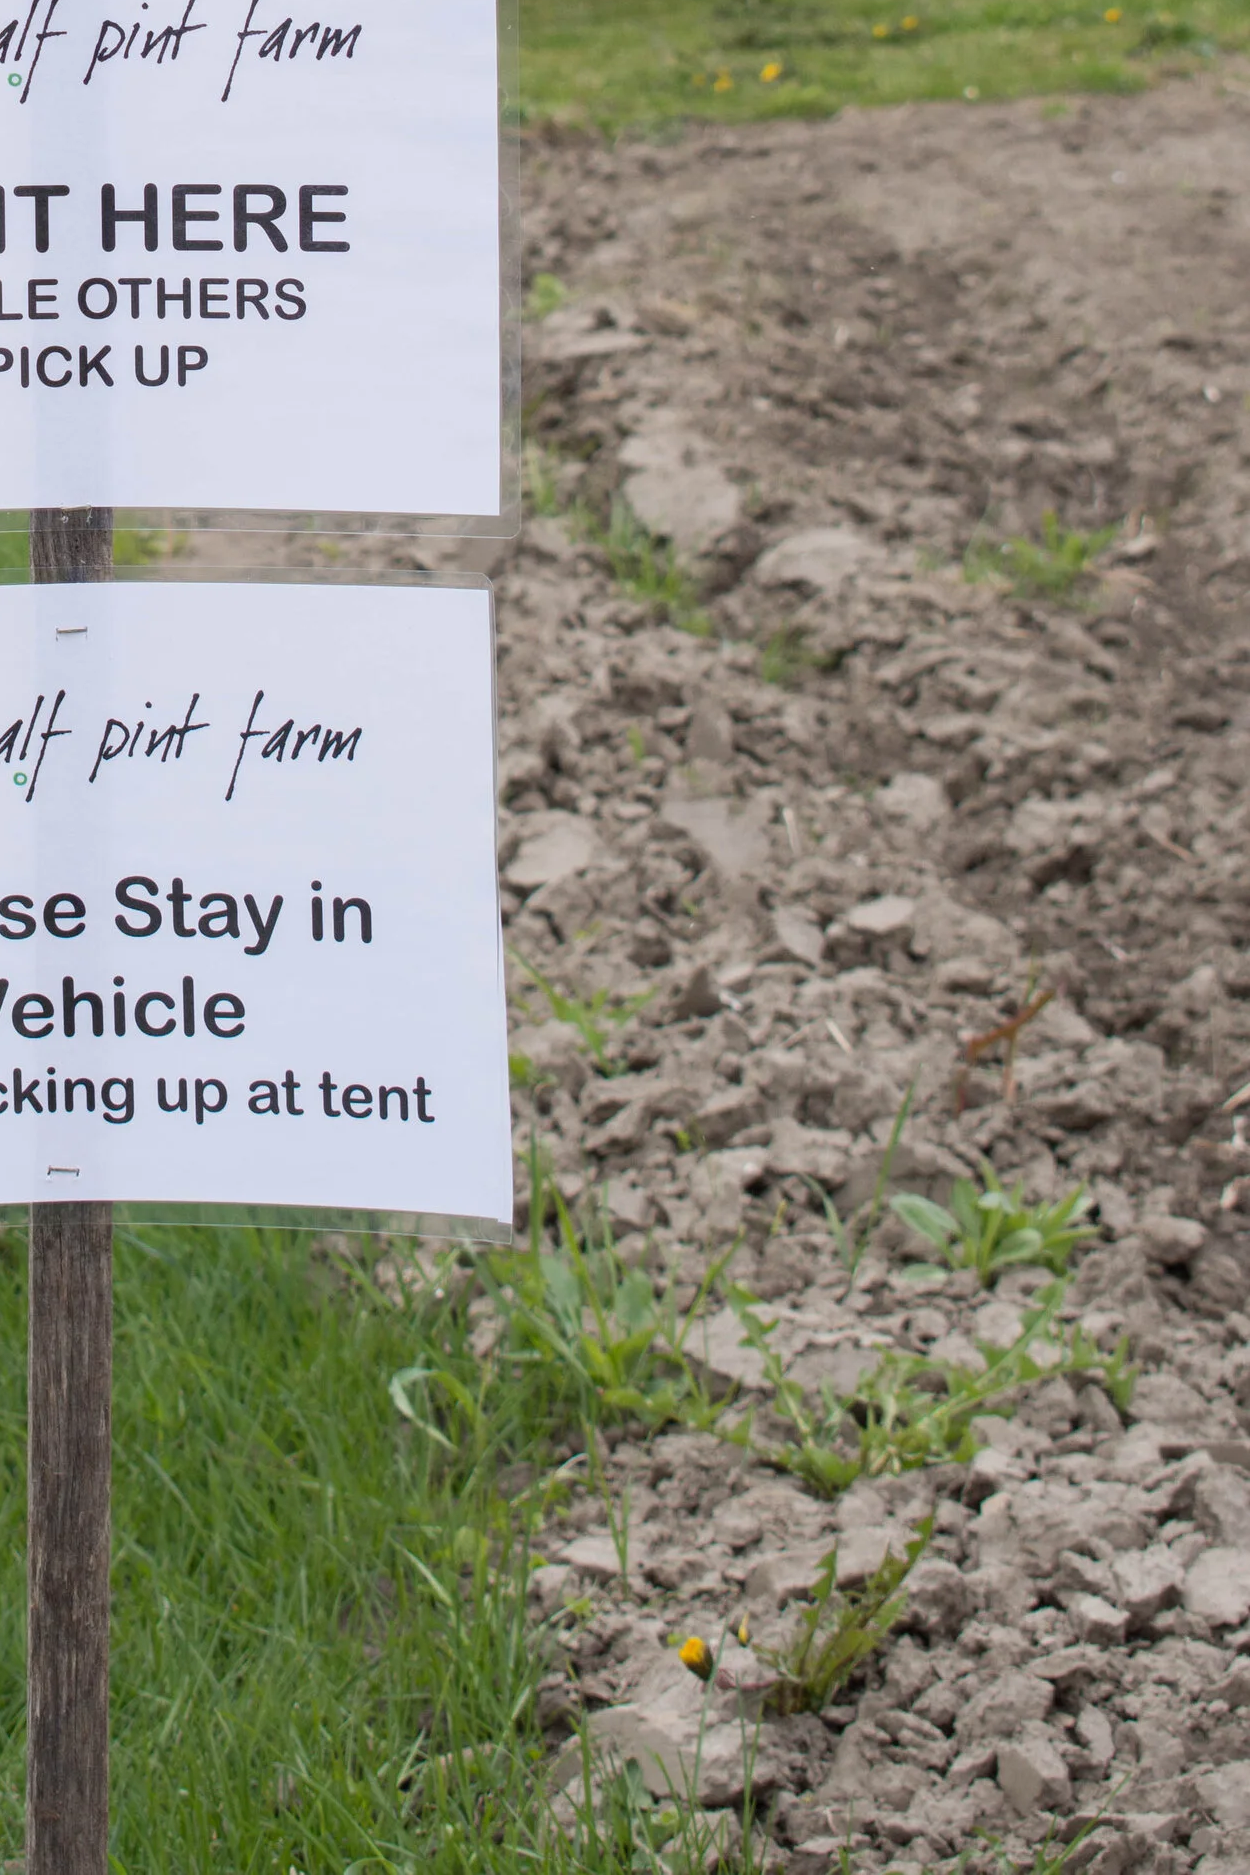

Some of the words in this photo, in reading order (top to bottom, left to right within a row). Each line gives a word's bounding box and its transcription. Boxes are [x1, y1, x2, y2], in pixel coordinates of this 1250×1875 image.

[101, 183, 350, 252] HERE
[78, 278, 306, 320] OTHERS
[135, 345, 208, 386] UP
[89, 693, 210, 783] pint
[225, 690, 362, 801] farm
[115, 876, 283, 955] Stay
[311, 881, 372, 943] in
[158, 1078, 227, 1125] up
[248, 1070, 304, 1115] at
[319, 1072, 435, 1122] tent
